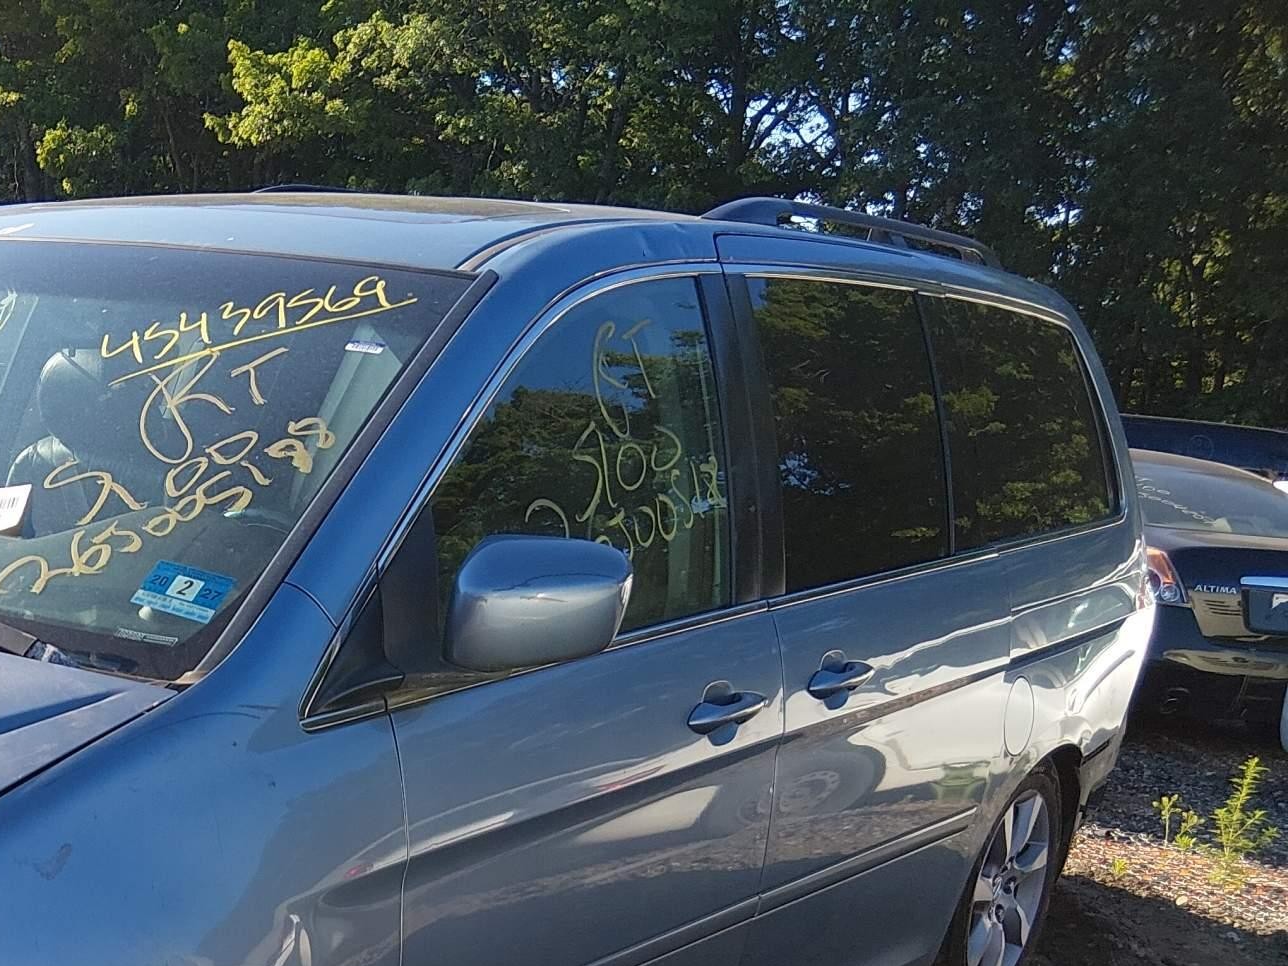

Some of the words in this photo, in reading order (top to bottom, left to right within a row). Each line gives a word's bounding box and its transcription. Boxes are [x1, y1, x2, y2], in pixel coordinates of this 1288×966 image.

[101, 275, 391, 364] 45439569
[139, 346, 289, 464] RT
[150, 573, 170, 587] 20
[176, 580, 195, 596] 2
[199, 588, 224, 601] 27
[1194, 584, 1238, 595] ALTIMA
